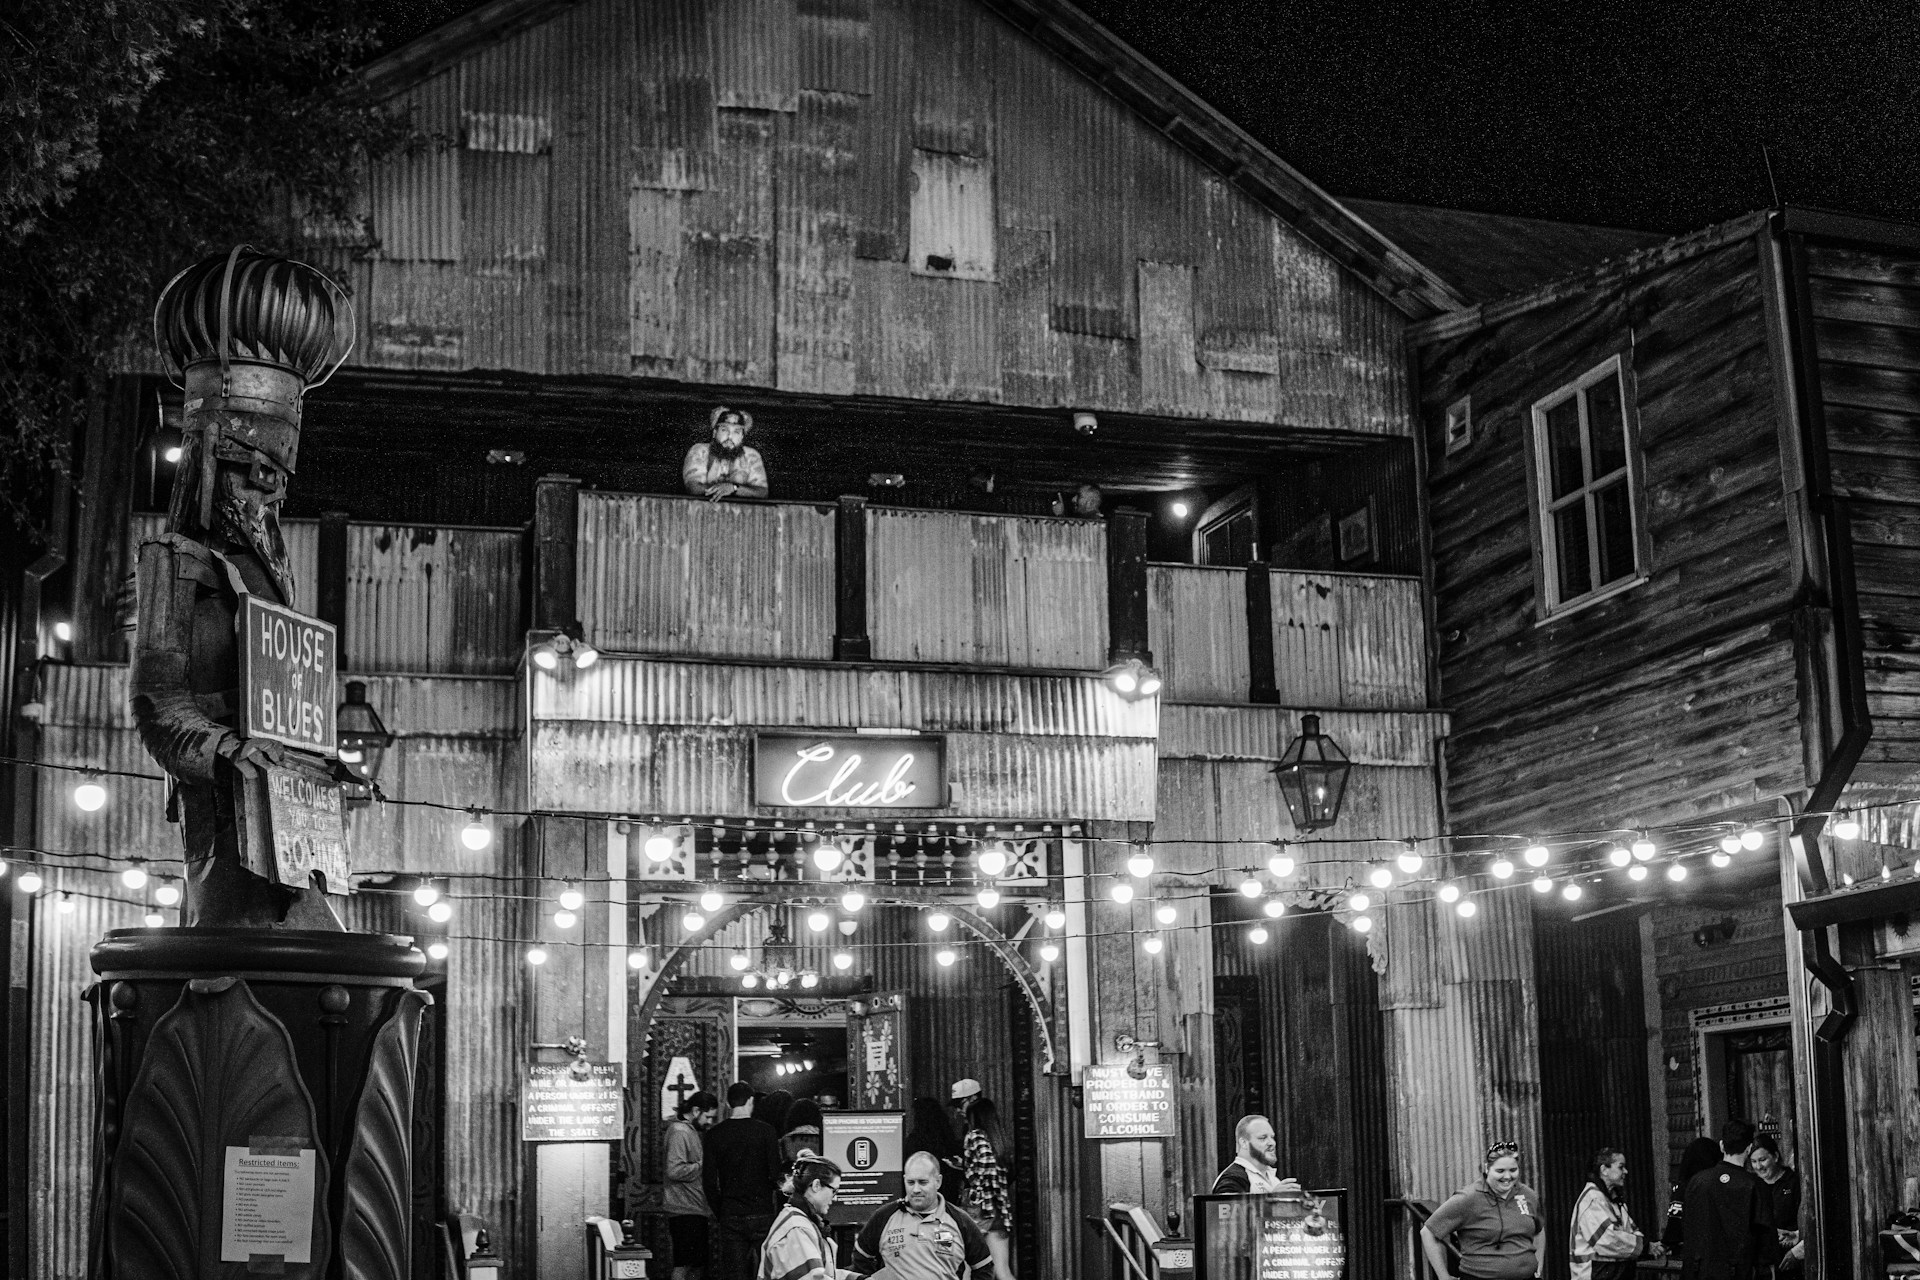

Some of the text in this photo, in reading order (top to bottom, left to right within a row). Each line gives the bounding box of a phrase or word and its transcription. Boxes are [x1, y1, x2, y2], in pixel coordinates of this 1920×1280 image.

[261, 612, 325, 673] HOUSE
[291, 673, 303, 691] OF
[262, 688, 324, 743] BLUES
[781, 745, 916, 806] Club
[272, 775, 337, 812] WELCOMES
[289, 808, 326, 831] YOU TO
[1092, 1068, 1127, 1079] MUST
[529, 1079, 553, 1088] WINE
[1086, 1079, 1138, 1090] PROPER
[1161, 1079, 1170, 1089] &
[527, 1091, 535, 1100] A
[535, 1091, 568, 1101] PERSON
[609, 1090, 619, 1099] IS
[1091, 1090, 1165, 1101] WRISTBAND
[528, 1104, 536, 1113] A
[537, 1103, 577, 1113] CRIMINAL
[1089, 1101, 1169, 1112] IN ORDER TO
[528, 1115, 616, 1125] UNDER THE LAWS OF
[1099, 1112, 1160, 1124] CONSUME
[549, 1128, 600, 1137] THE STATE
[1100, 1124, 1160, 1135] ALCOHOL
[238, 1158, 275, 1168] Restricted
[1270, 1245, 1302, 1255] PERSON
[1271, 1257, 1311, 1267] CRIMINAL
[1262, 1269, 1290, 1279] UNDER
[1292, 1269, 1309, 1279] THE
[1310, 1269, 1334, 1279] LAWS
